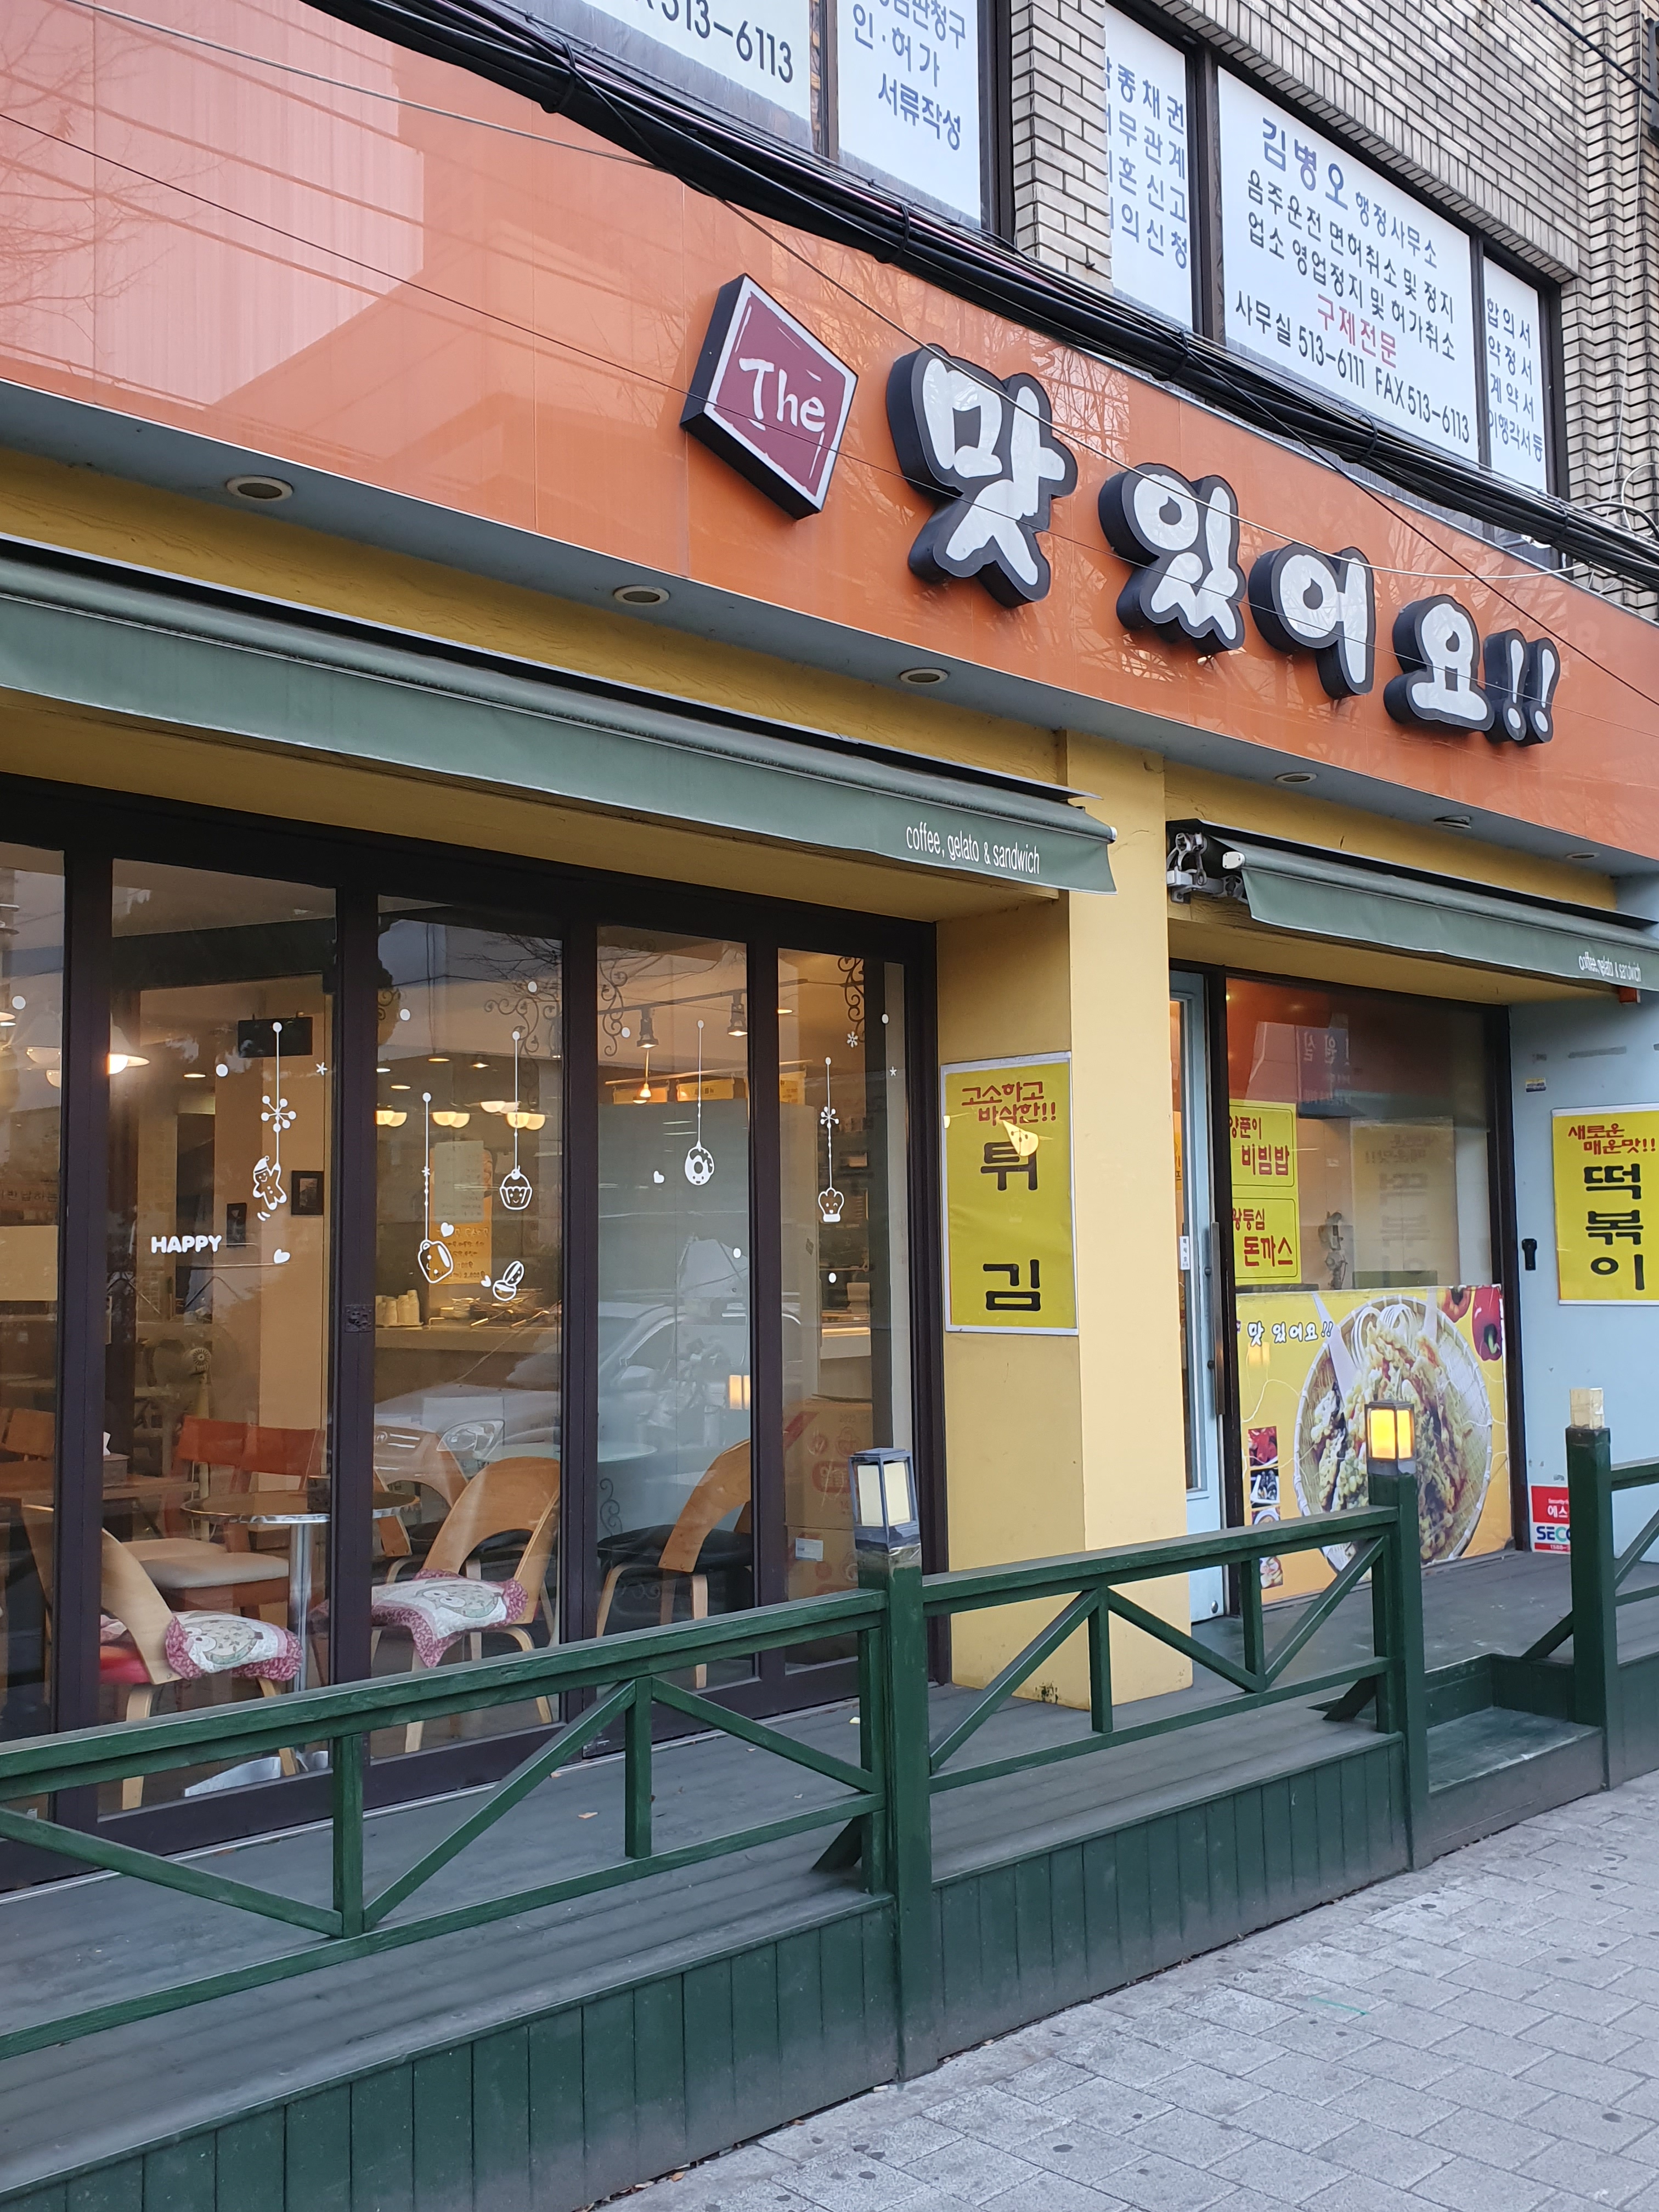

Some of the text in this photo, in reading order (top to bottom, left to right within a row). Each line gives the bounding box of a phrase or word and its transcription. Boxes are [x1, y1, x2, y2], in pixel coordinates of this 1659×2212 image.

[881, 0, 966, 49] 판청구
[878, 72, 961, 151] 서류작성
[1263, 117, 1437, 269] 김병오 행정사무소
[1248, 170, 1453, 324] 음주운전 면허취소 및 정지
[1249, 212, 1455, 361] 업소 영업정지 및 허가취소
[1317, 293, 1397, 368] 구제전문
[1487, 297, 1531, 349] 합의서
[1235, 290, 1470, 443] 사무실 513-6111 FAX 513-6113
[1488, 335, 1532, 385] 약정서
[739, 357, 826, 432] The
[1490, 373, 1534, 422] 계약서
[906, 821, 1040, 874] coffee, gelato & sandwich
[962, 1081, 1044, 1106] 고소하고
[978, 1102, 1056, 1126] 바삭한!!
[1229, 1115, 1261, 1140] 양푼이
[1568, 1123, 1625, 1140] 새로운
[1584, 1138, 1656, 1155] 매운맛!!
[1242, 1143, 1290, 1176] 비빔밥
[151, 1235, 222, 1254] HAPPY
[1244, 1235, 1293, 1267] 돈까스
[1583, 1163, 1645, 1291] 떡볶이
